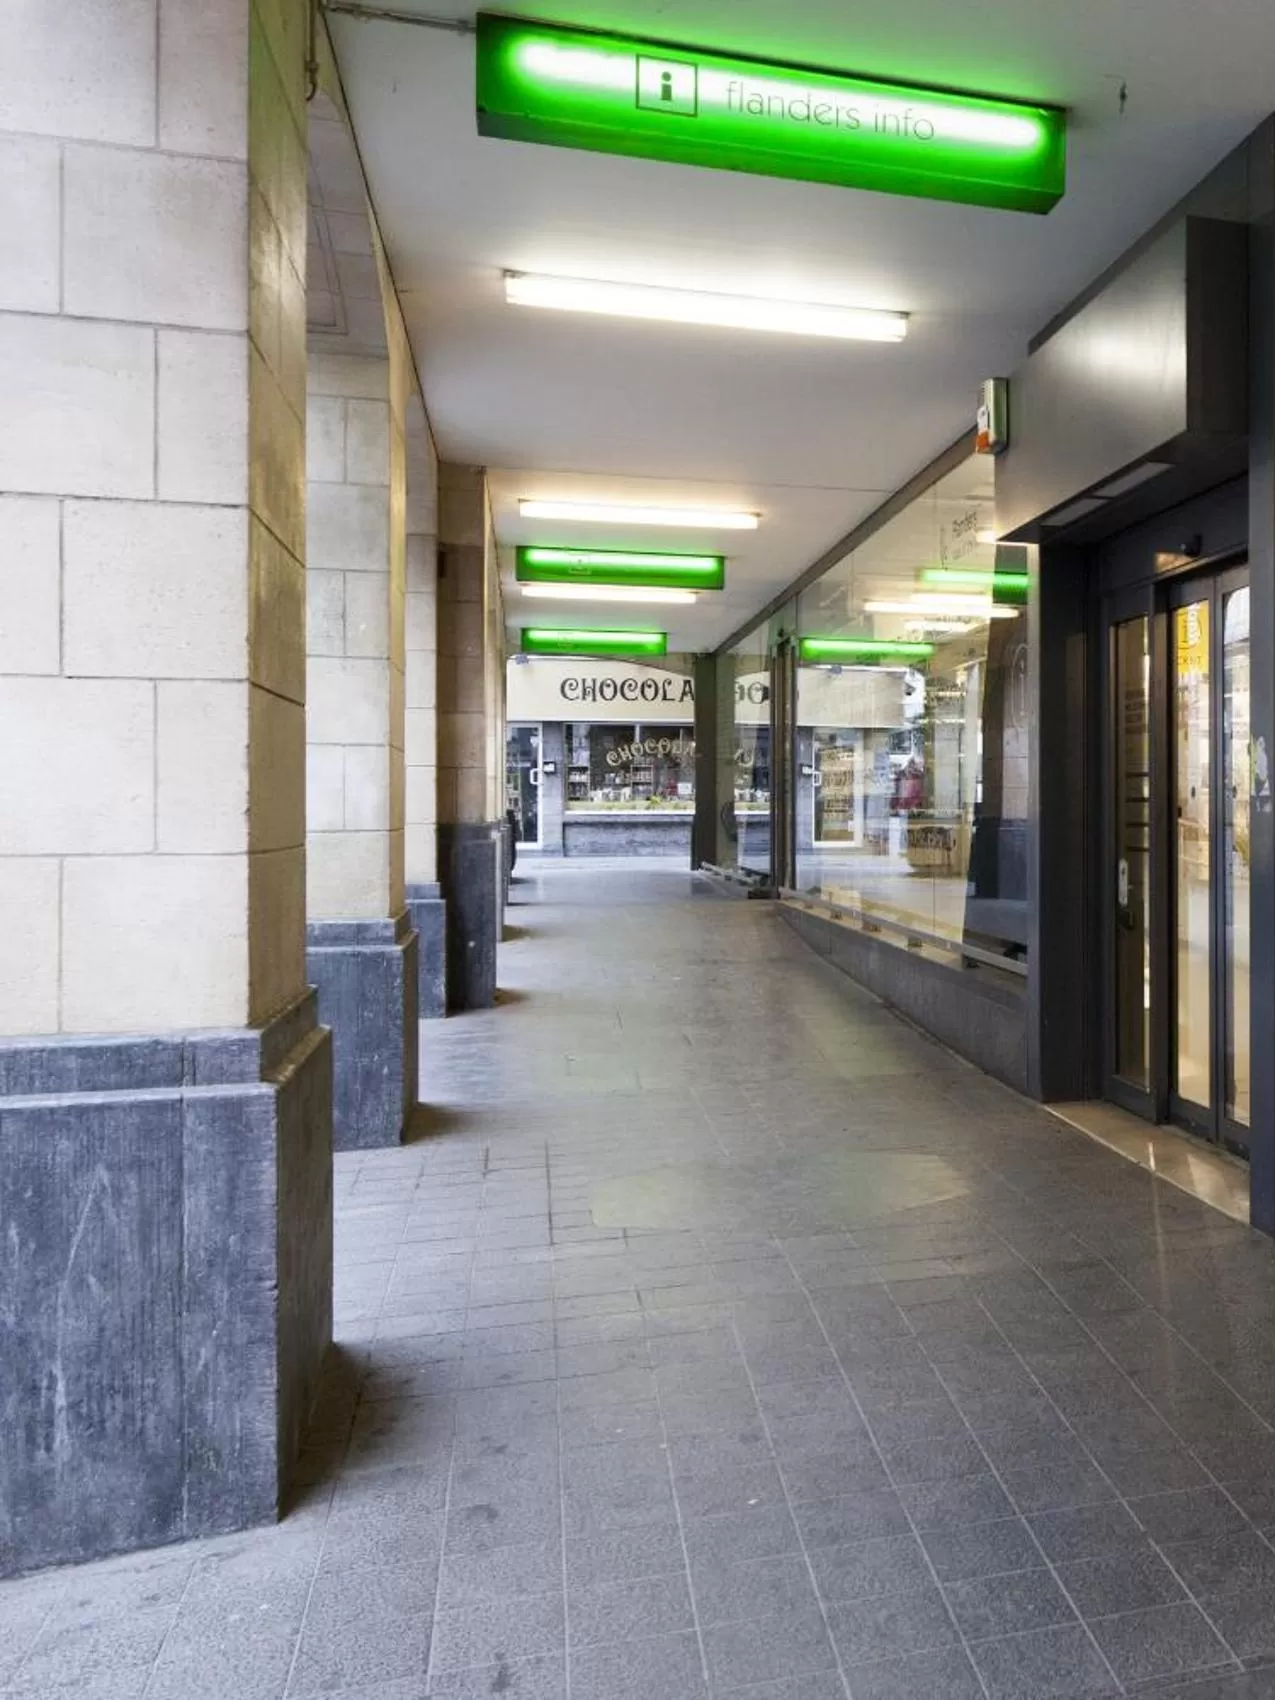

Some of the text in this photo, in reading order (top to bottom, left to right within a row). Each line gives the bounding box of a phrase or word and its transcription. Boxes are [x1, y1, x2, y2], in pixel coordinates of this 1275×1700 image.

[726, 80, 861, 130] flanders
[874, 103, 935, 141] info
[560, 677, 695, 702] CHOCOLA
